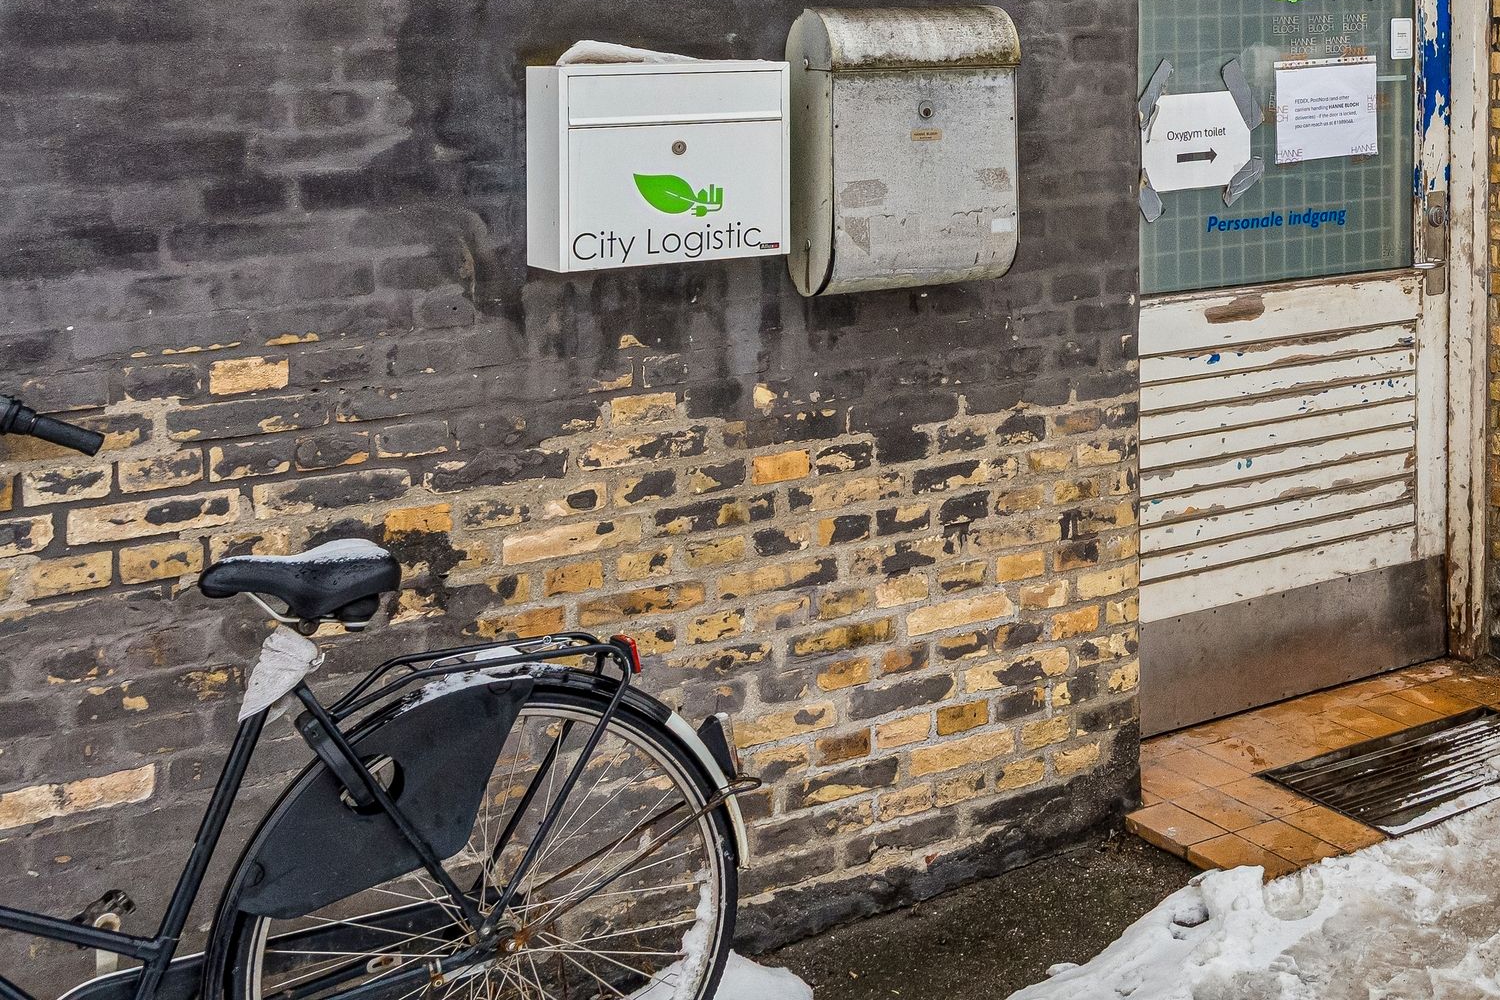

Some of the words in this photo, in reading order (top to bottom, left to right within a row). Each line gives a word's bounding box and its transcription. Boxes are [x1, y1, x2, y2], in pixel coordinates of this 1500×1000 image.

[1272, 15, 1300, 25] HANNE
[1308, 14, 1334, 24] HANNE
[1342, 13, 1368, 23] HANNE
[1272, 25, 1300, 34] BLOCH
[1308, 23, 1334, 33] BLOCH
[1342, 22, 1368, 32] BLOCH
[1290, 37, 1317, 46] HANNE
[1325, 35, 1351, 45] HANNE
[1167, 130, 1202, 142] Oxygym
[1204, 127, 1226, 137] toilet
[1207, 211, 1283, 232] Personale
[1288, 208, 1347, 230] indgang
[573, 231, 635, 263] City
[648, 221, 762, 258] Logistic
